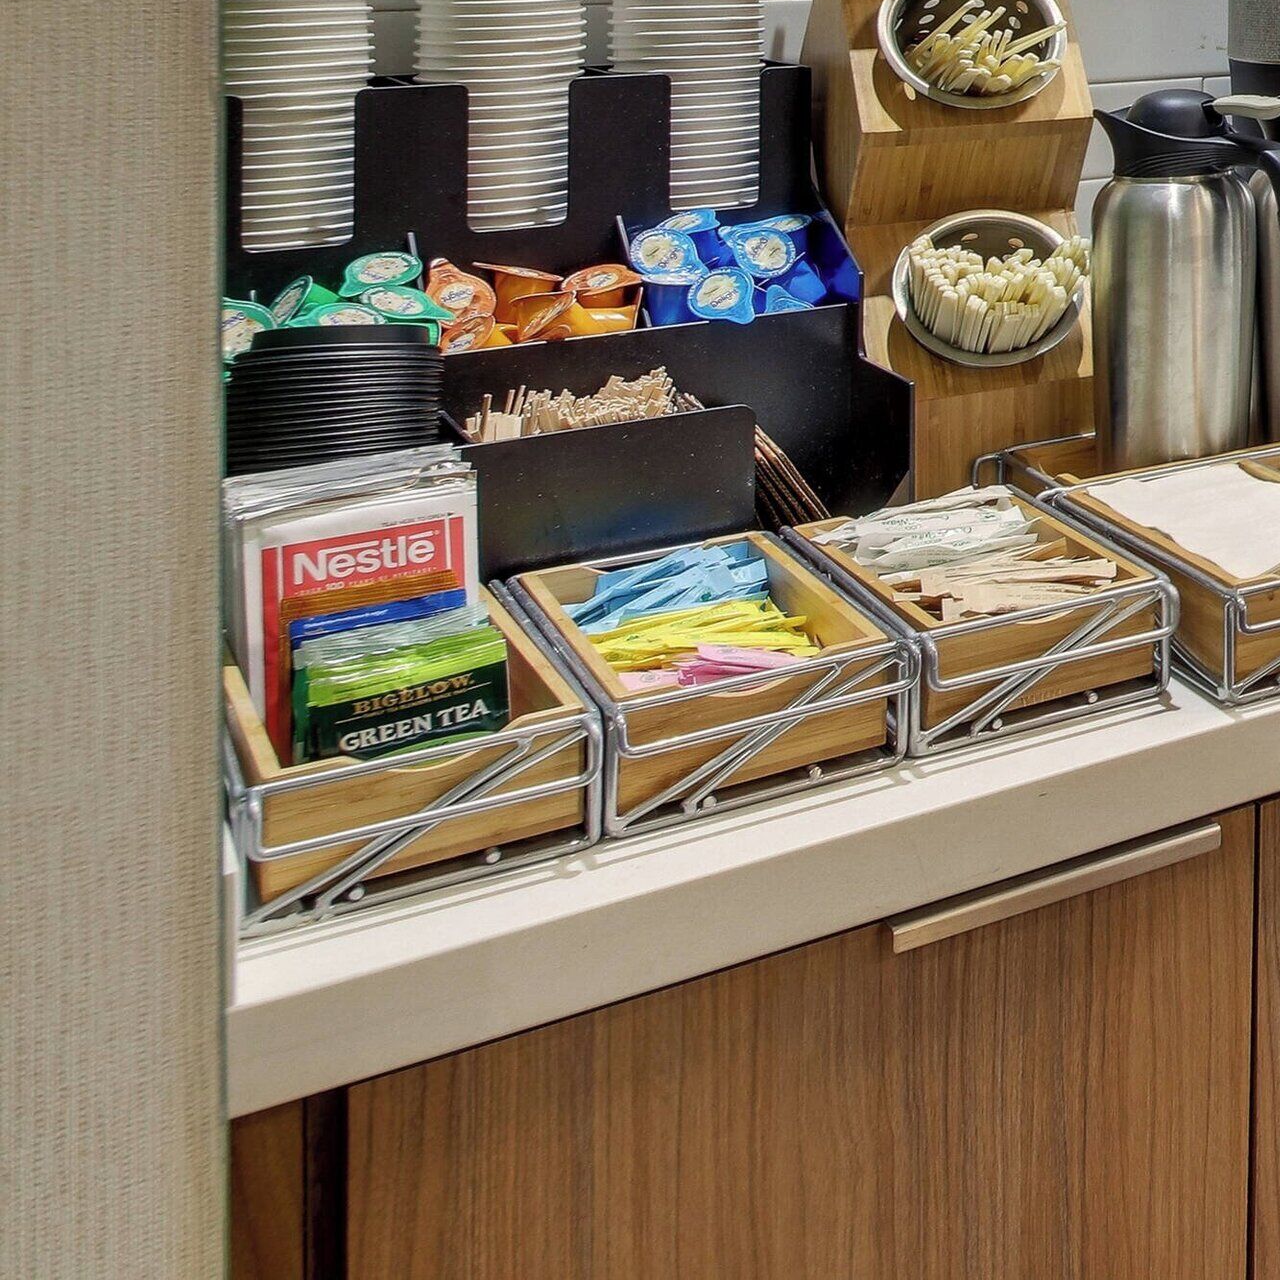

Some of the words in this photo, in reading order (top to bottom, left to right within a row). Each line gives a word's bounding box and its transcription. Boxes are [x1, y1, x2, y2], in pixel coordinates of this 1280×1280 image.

[293, 531, 435, 585] Nestlé
[352, 673, 472, 714] BIGELOW
[340, 713, 433, 752] GREEN
[436, 698, 491, 727] TEA
